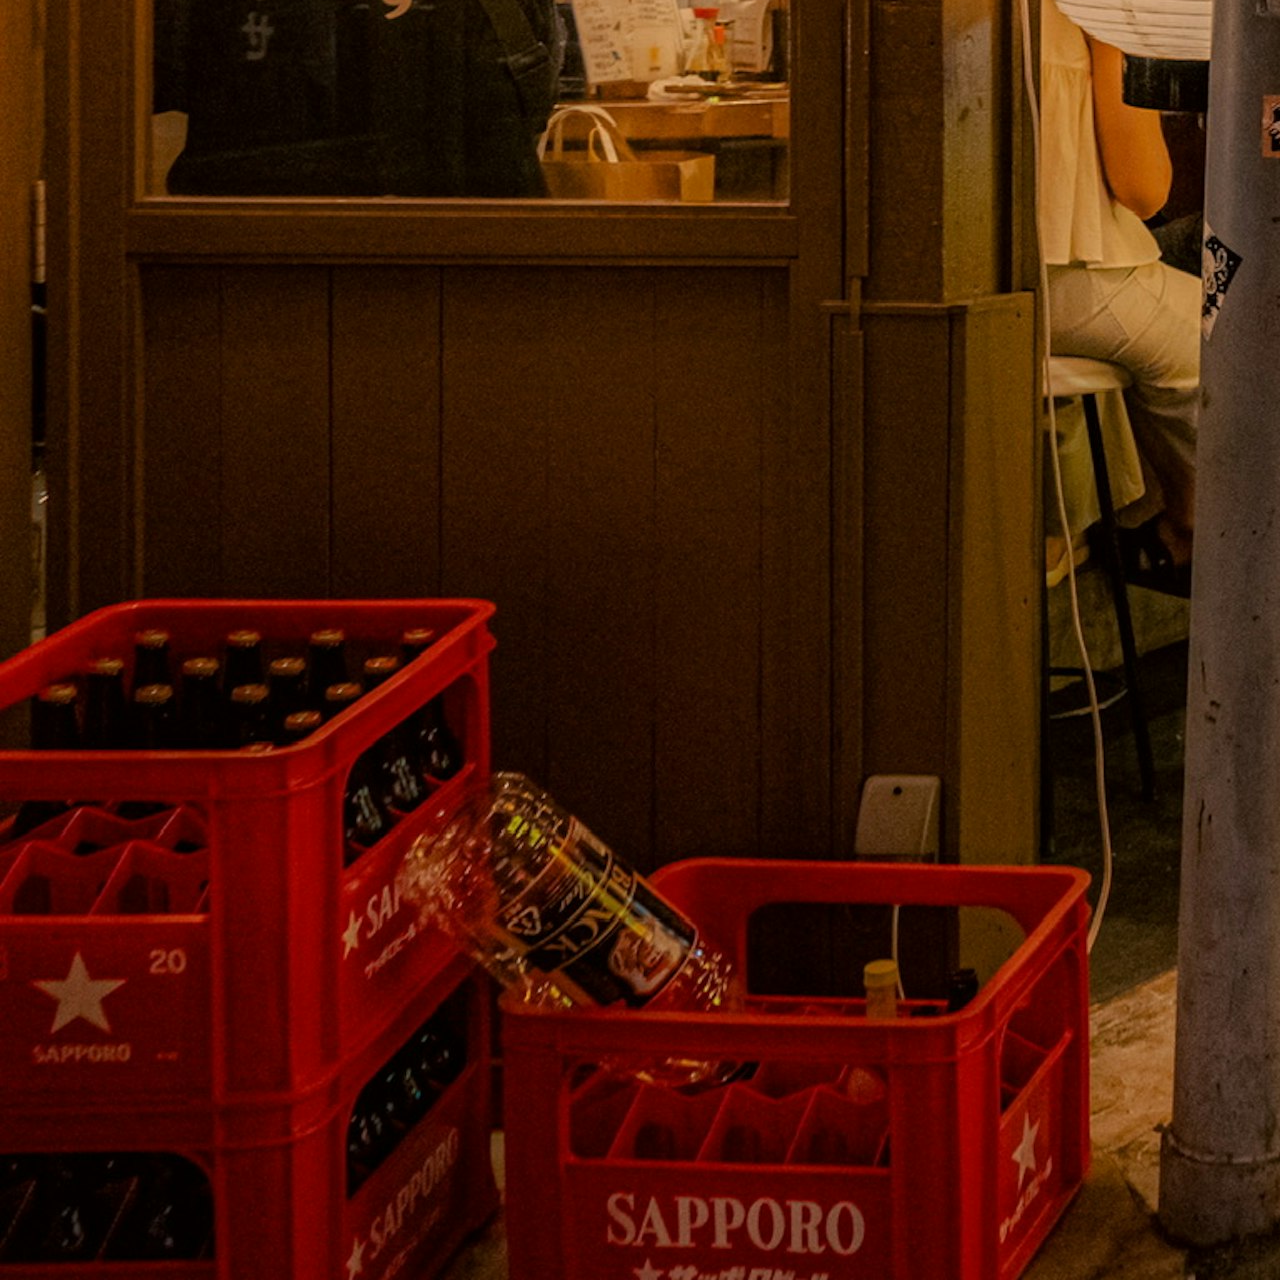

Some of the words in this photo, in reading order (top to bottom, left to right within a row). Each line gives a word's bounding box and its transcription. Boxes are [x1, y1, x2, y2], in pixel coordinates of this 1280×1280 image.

[149, 948, 187, 974] 20
[32, 1041, 133, 1064] SAPPORO
[370, 1126, 459, 1261] SAPPORO
[606, 1191, 865, 1256] SAPPORO
